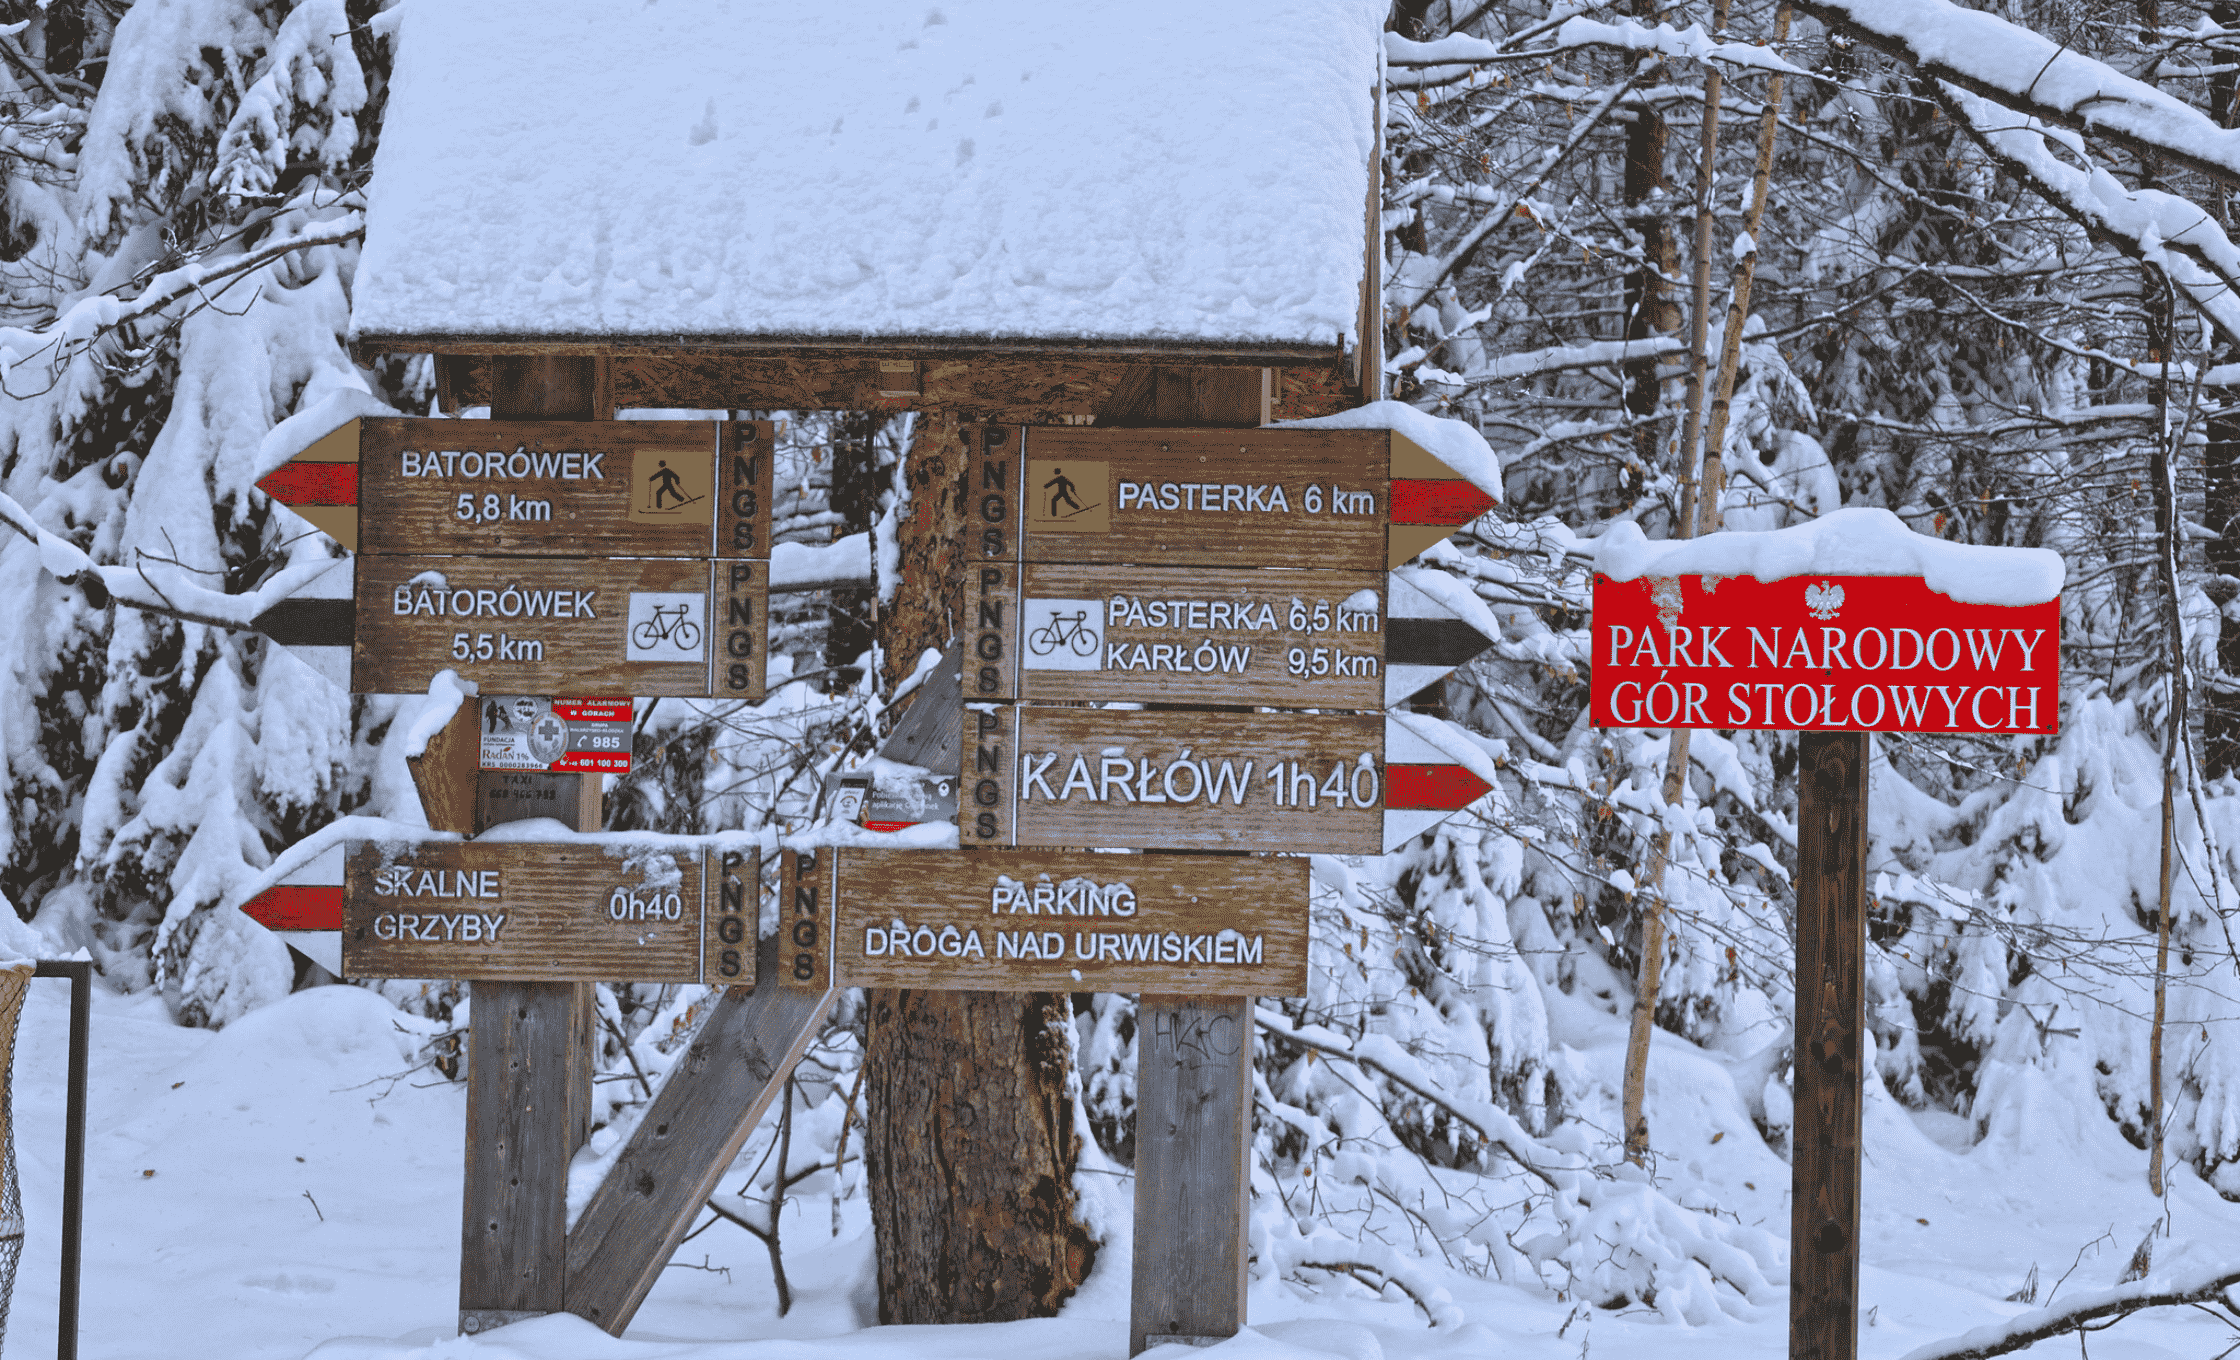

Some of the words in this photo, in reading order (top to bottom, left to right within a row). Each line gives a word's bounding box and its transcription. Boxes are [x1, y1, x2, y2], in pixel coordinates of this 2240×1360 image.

[402, 447, 604, 480] BATORÓWEK
[733, 422, 759, 552] PNGS
[979, 426, 1006, 556] PNGS
[1118, 482, 1290, 513] PASTERKA
[1303, 485, 1323, 514] 6
[1331, 485, 1375, 515] km
[456, 494, 501, 524] 5,8
[509, 495, 552, 522] km
[393, 585, 597, 619] BATORÓWEK
[1108, 600, 1279, 631] PASTERKA
[1288, 603, 1330, 636] 6,5
[1335, 604, 1380, 632] km
[727, 565, 753, 691] PNGS
[977, 569, 1004, 694] PNGS
[452, 633, 498, 664] 5,5
[501, 634, 544, 662] km
[1107, 639, 1251, 674] KARŁÓW
[1287, 648, 1330, 679] 9,5
[1335, 649, 1378, 677] km
[1607, 625, 1734, 668] PARK
[1747, 626, 2047, 672] NARODOWY
[1609, 669, 1713, 725] GÓR
[1727, 682, 2042, 730] STOŁOWYCH
[592, 736, 620, 749] 985
[580, 758, 595, 767] 601
[597, 759, 612, 768] 100
[613, 760, 629, 768] 300
[975, 714, 999, 839] PNGS
[1022, 748, 1253, 804] KARŁÓW
[1266, 761, 1379, 809] 1h40
[373, 869, 500, 898] SKALNE
[992, 884, 1137, 917] PARKING
[609, 892, 682, 922] 0h40
[373, 913, 505, 942] GRZYBY
[865, 927, 986, 959] DROGA
[996, 931, 1065, 960] NAD
[1075, 931, 1263, 965] URWISKIEM
